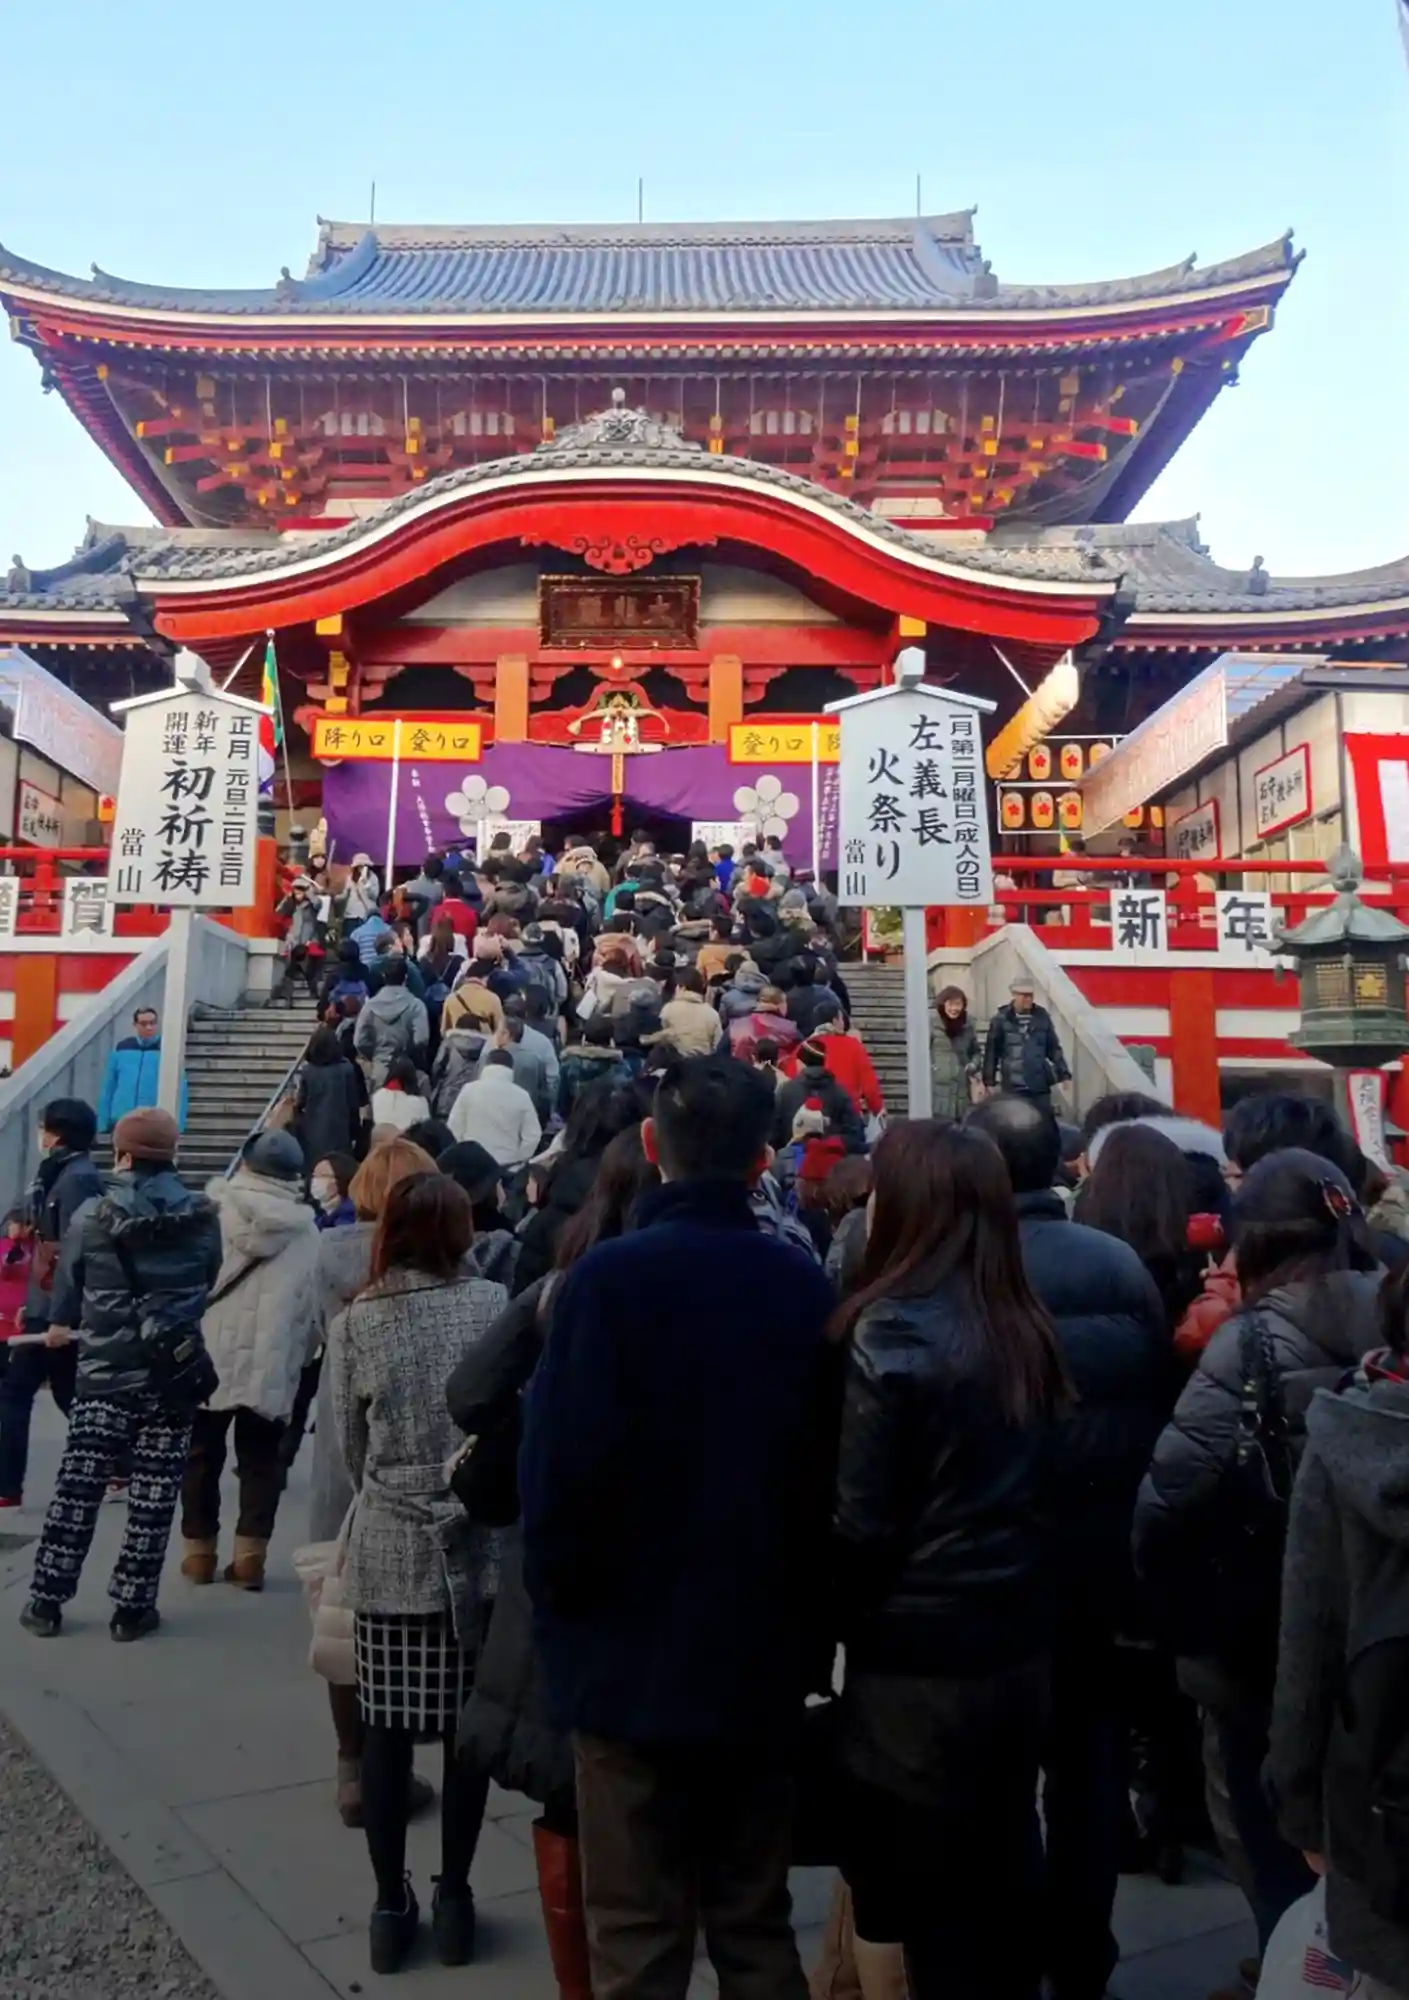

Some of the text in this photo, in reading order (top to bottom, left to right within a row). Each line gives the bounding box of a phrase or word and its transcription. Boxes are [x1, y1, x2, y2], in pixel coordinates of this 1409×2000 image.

[162, 711, 189, 756] 開運
[192, 710, 220, 756] 新年
[324, 727, 386, 749] 降り口
[410, 728, 470, 752] 登り口
[743, 732, 804, 756] 登り口
[908, 713, 952, 847] 左義長
[152, 758, 216, 896] 初祈祷
[866, 747, 908, 881] 火祭り
[116, 827, 146, 894] 當山
[845, 838, 866, 896] 當山
[68, 882, 108, 936] 賀
